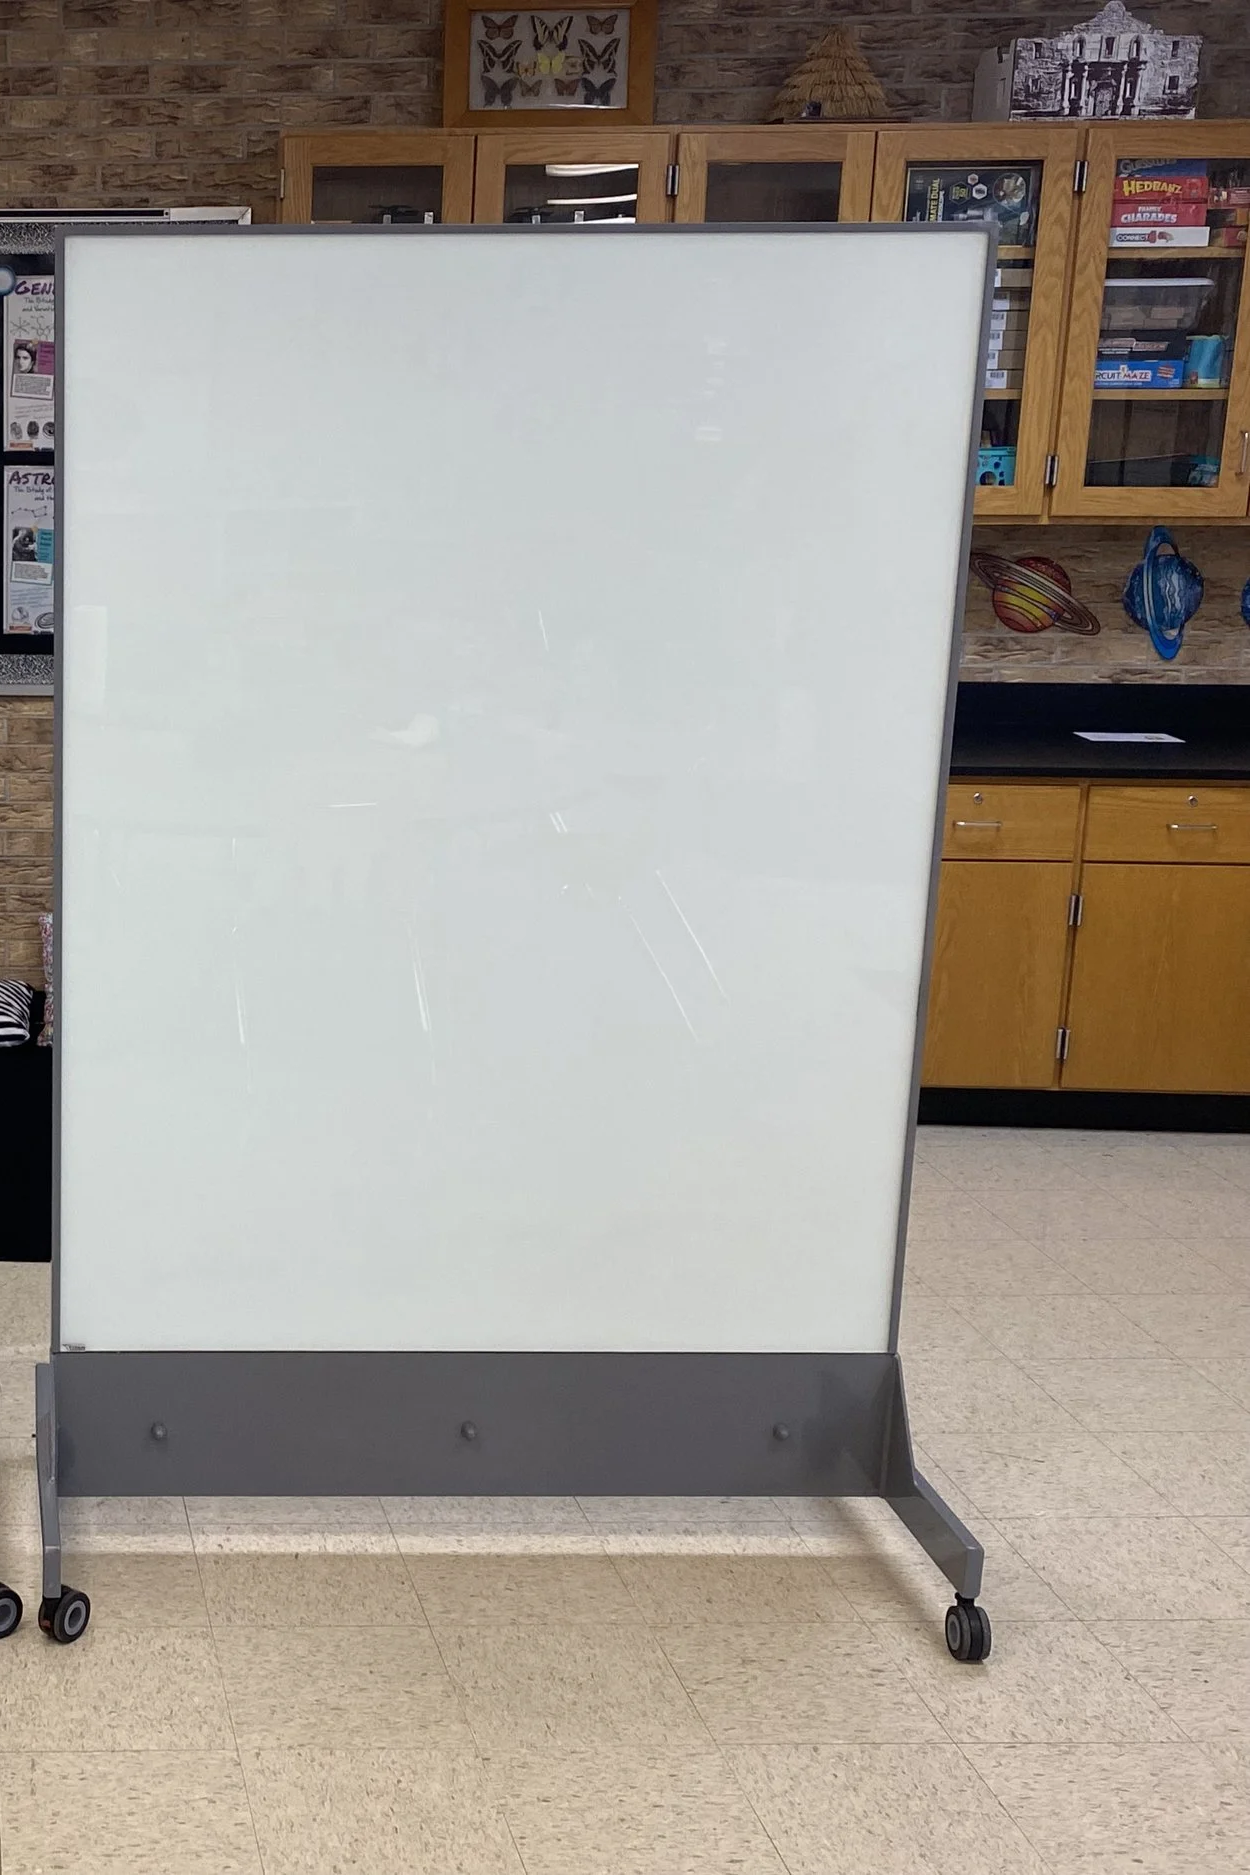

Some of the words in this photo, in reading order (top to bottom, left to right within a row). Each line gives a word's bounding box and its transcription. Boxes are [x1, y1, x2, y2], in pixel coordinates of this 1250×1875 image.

[1122, 179, 1183, 197] HEDBANZ
[1120, 212, 1178, 224] CHARADES
[14, 280, 55, 296] GEN
[1123, 371, 1150, 380] MAZE
